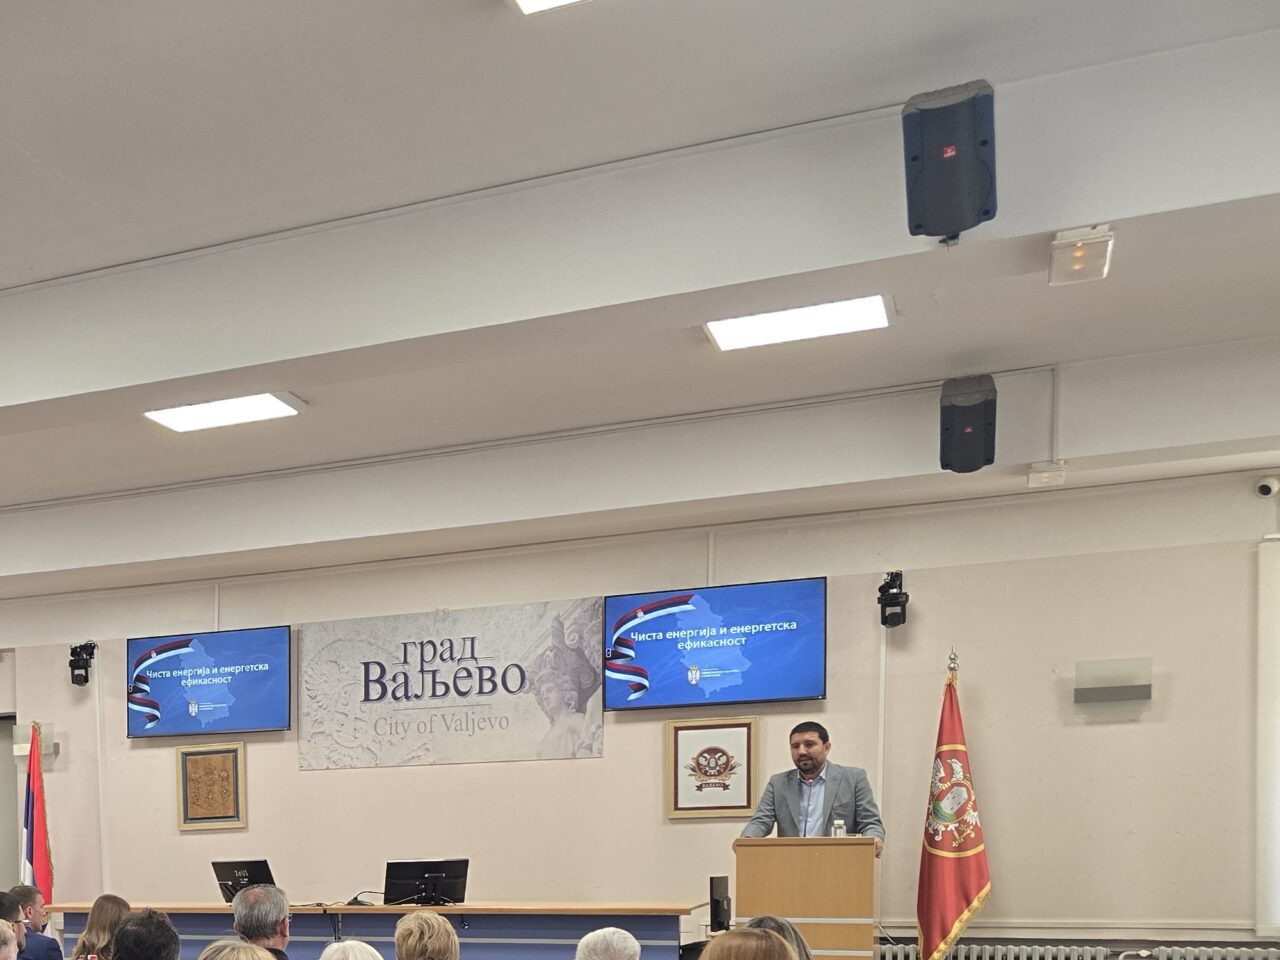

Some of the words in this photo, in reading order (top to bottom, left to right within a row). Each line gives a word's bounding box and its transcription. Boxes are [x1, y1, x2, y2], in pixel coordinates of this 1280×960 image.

[630, 629, 663, 642] Чиста
[666, 626, 717, 640] енергија
[719, 626, 727, 635] и
[730, 621, 798, 635] енергетска
[400, 636, 480, 673] град
[677, 636, 747, 652] ефикасност
[146, 669, 171, 679] Чиста
[173, 666, 210, 678] енергија
[211, 667, 218, 675] и
[220, 663, 269, 675] енергетска
[181, 676, 232, 687] ефикасност
[360, 660, 527, 703] Ваљево
[374, 717, 410, 738] City
[417, 714, 437, 734] of
[439, 711, 510, 737] Valjevo
